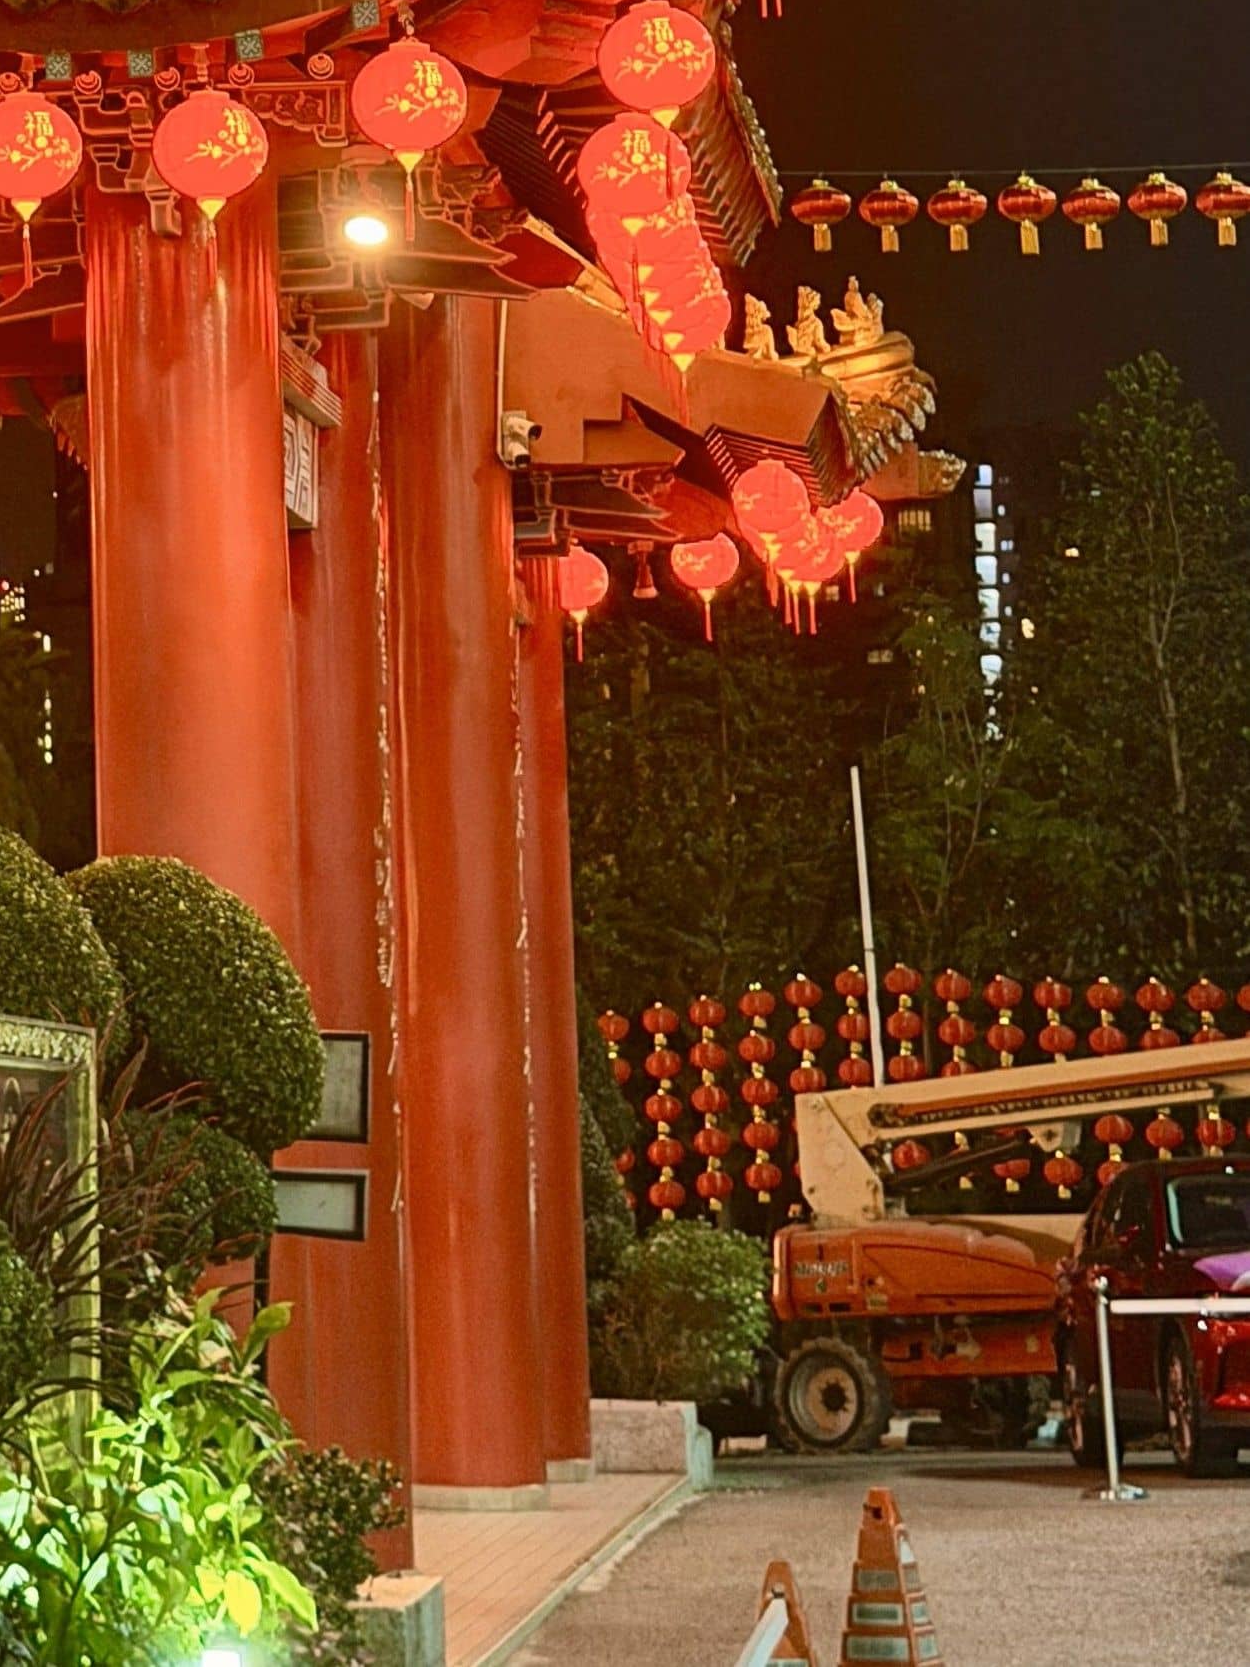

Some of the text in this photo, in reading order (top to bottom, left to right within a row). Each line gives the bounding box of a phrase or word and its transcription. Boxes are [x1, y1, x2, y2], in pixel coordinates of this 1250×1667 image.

[642, 17, 674, 42] 福
[414, 62, 442, 87] 福
[25, 111, 53, 136] 福
[623, 129, 651, 154] 福
